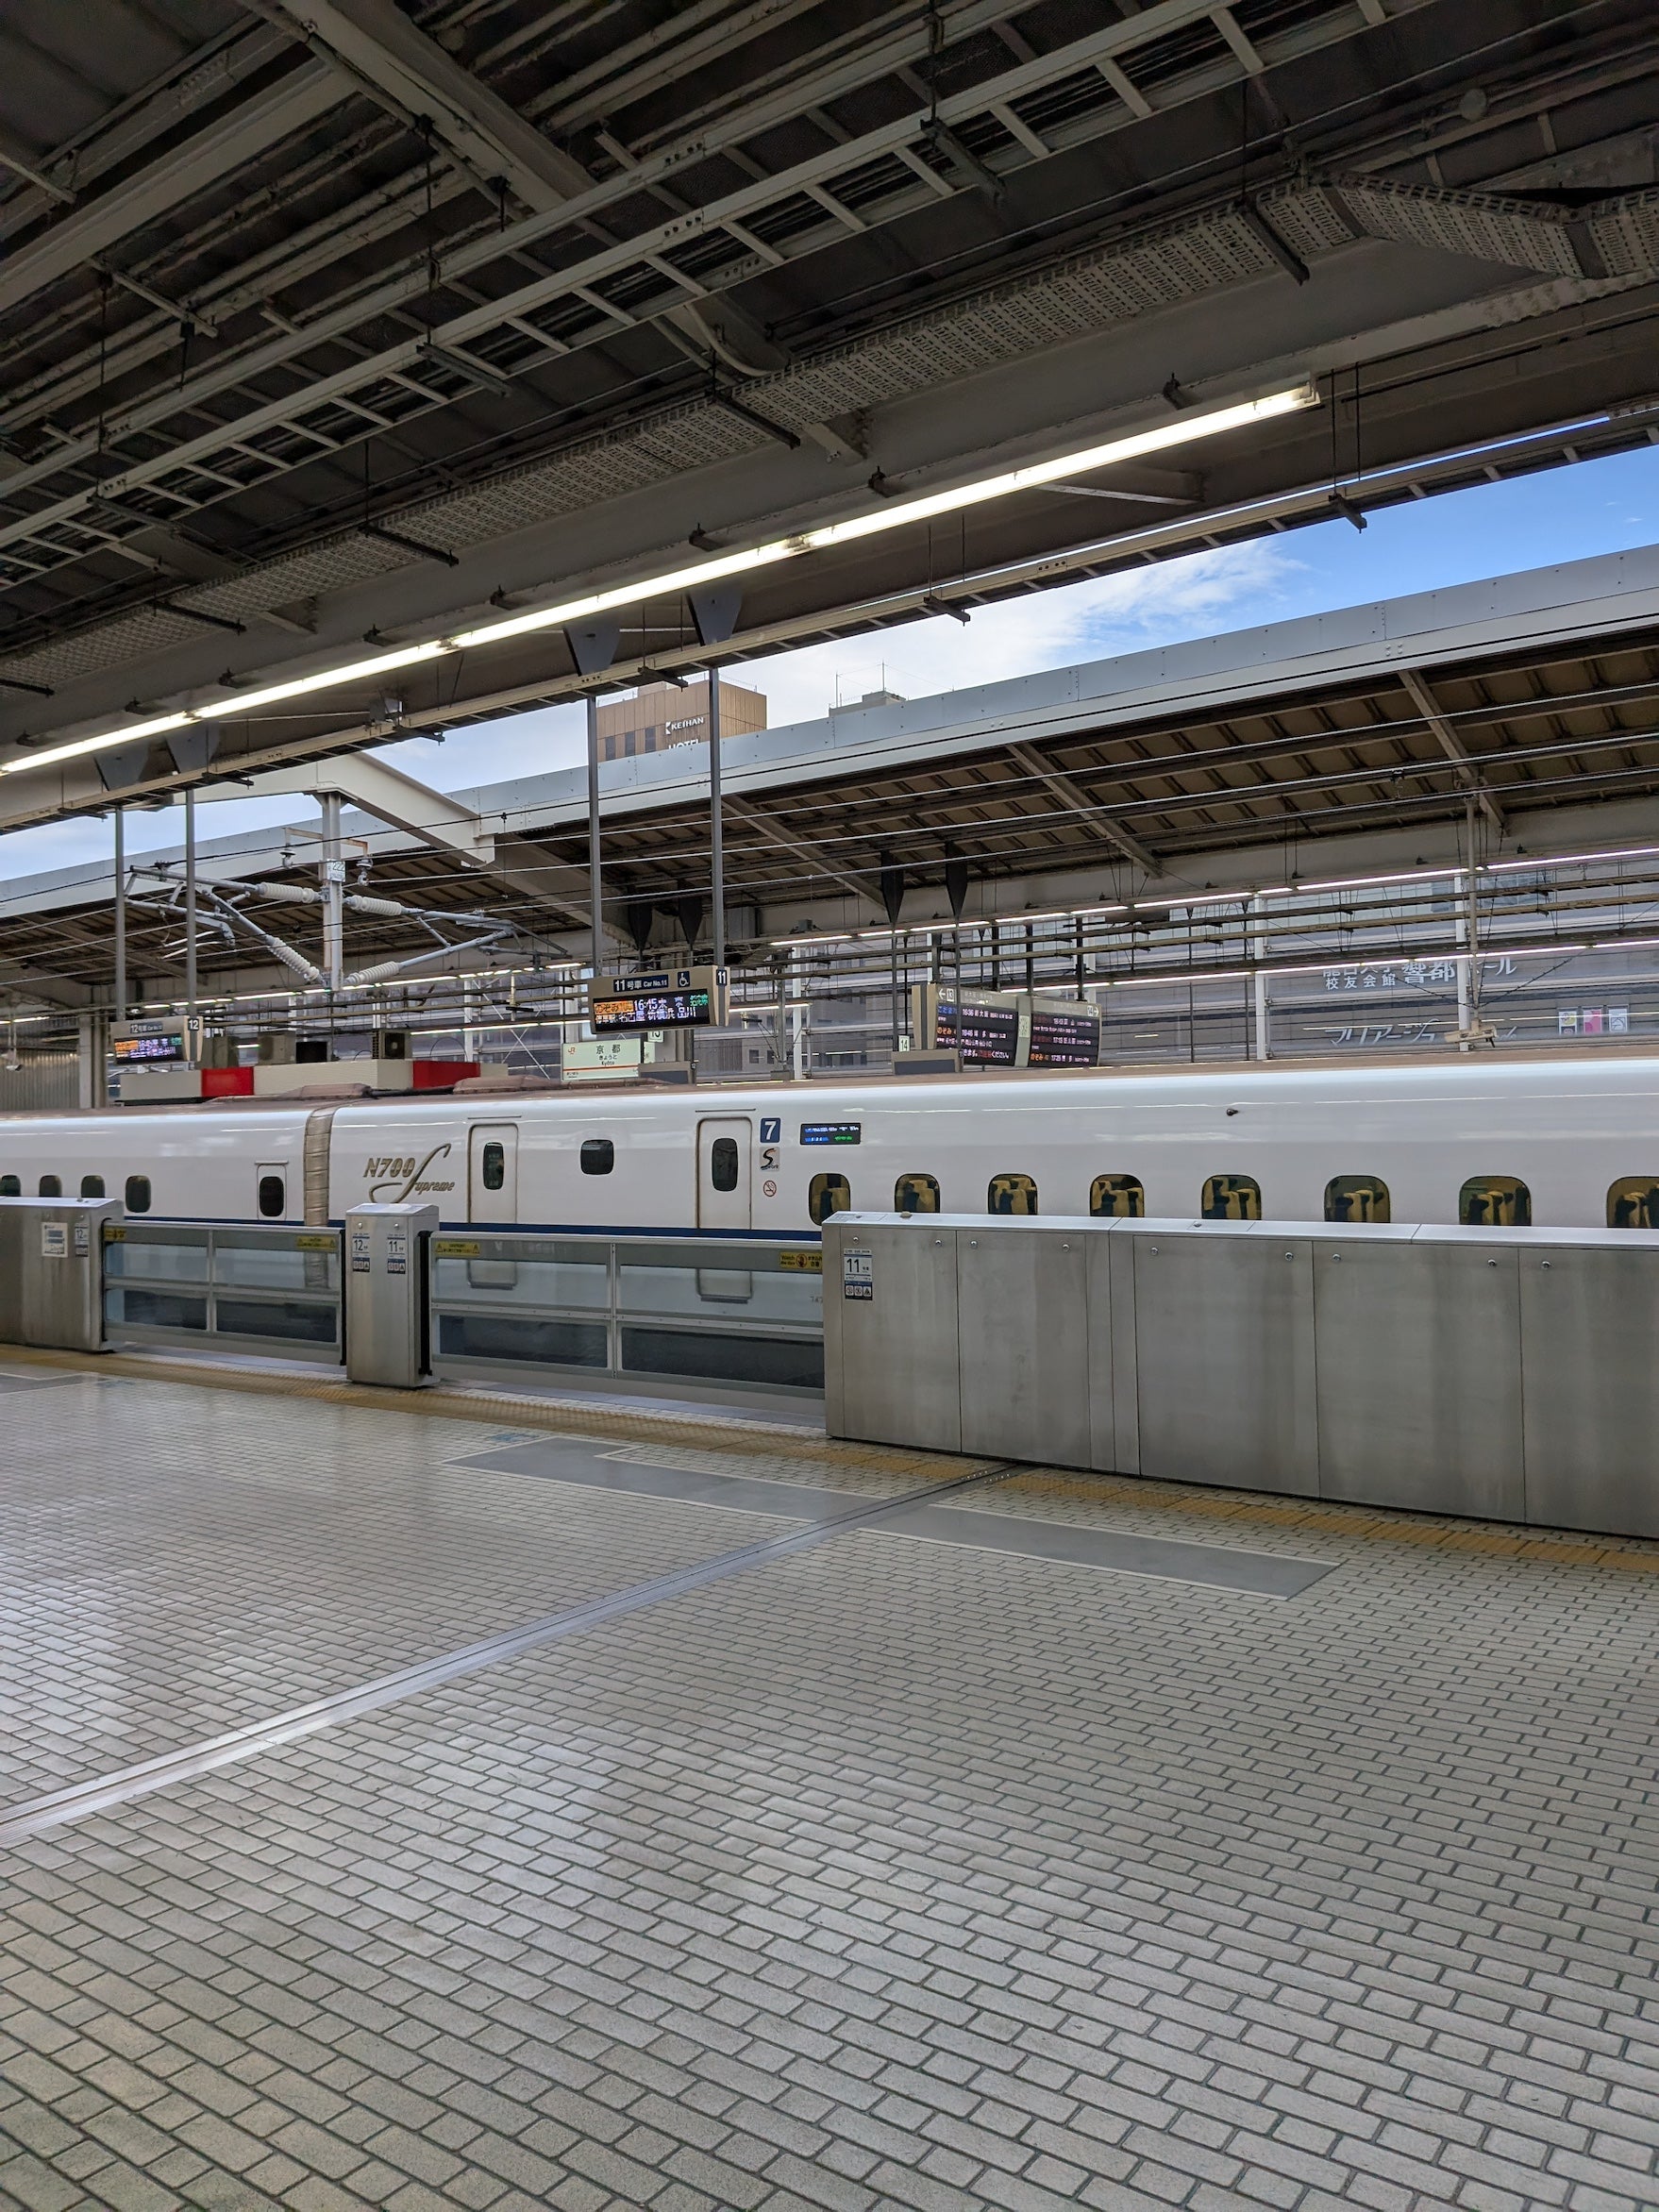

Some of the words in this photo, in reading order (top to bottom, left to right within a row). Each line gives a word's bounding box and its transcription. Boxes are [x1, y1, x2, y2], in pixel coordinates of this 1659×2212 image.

[671, 717, 704, 730] KEIHAN
[718, 971, 726, 984] 11
[1326, 973, 1396, 990] 校友会館
[189, 1020, 199, 1031] 12
[596, 1044, 621, 1054] 京都
[764, 1120, 777, 1141] 7
[362, 1157, 415, 1178] N700
[846, 1258, 860, 1273] 11
